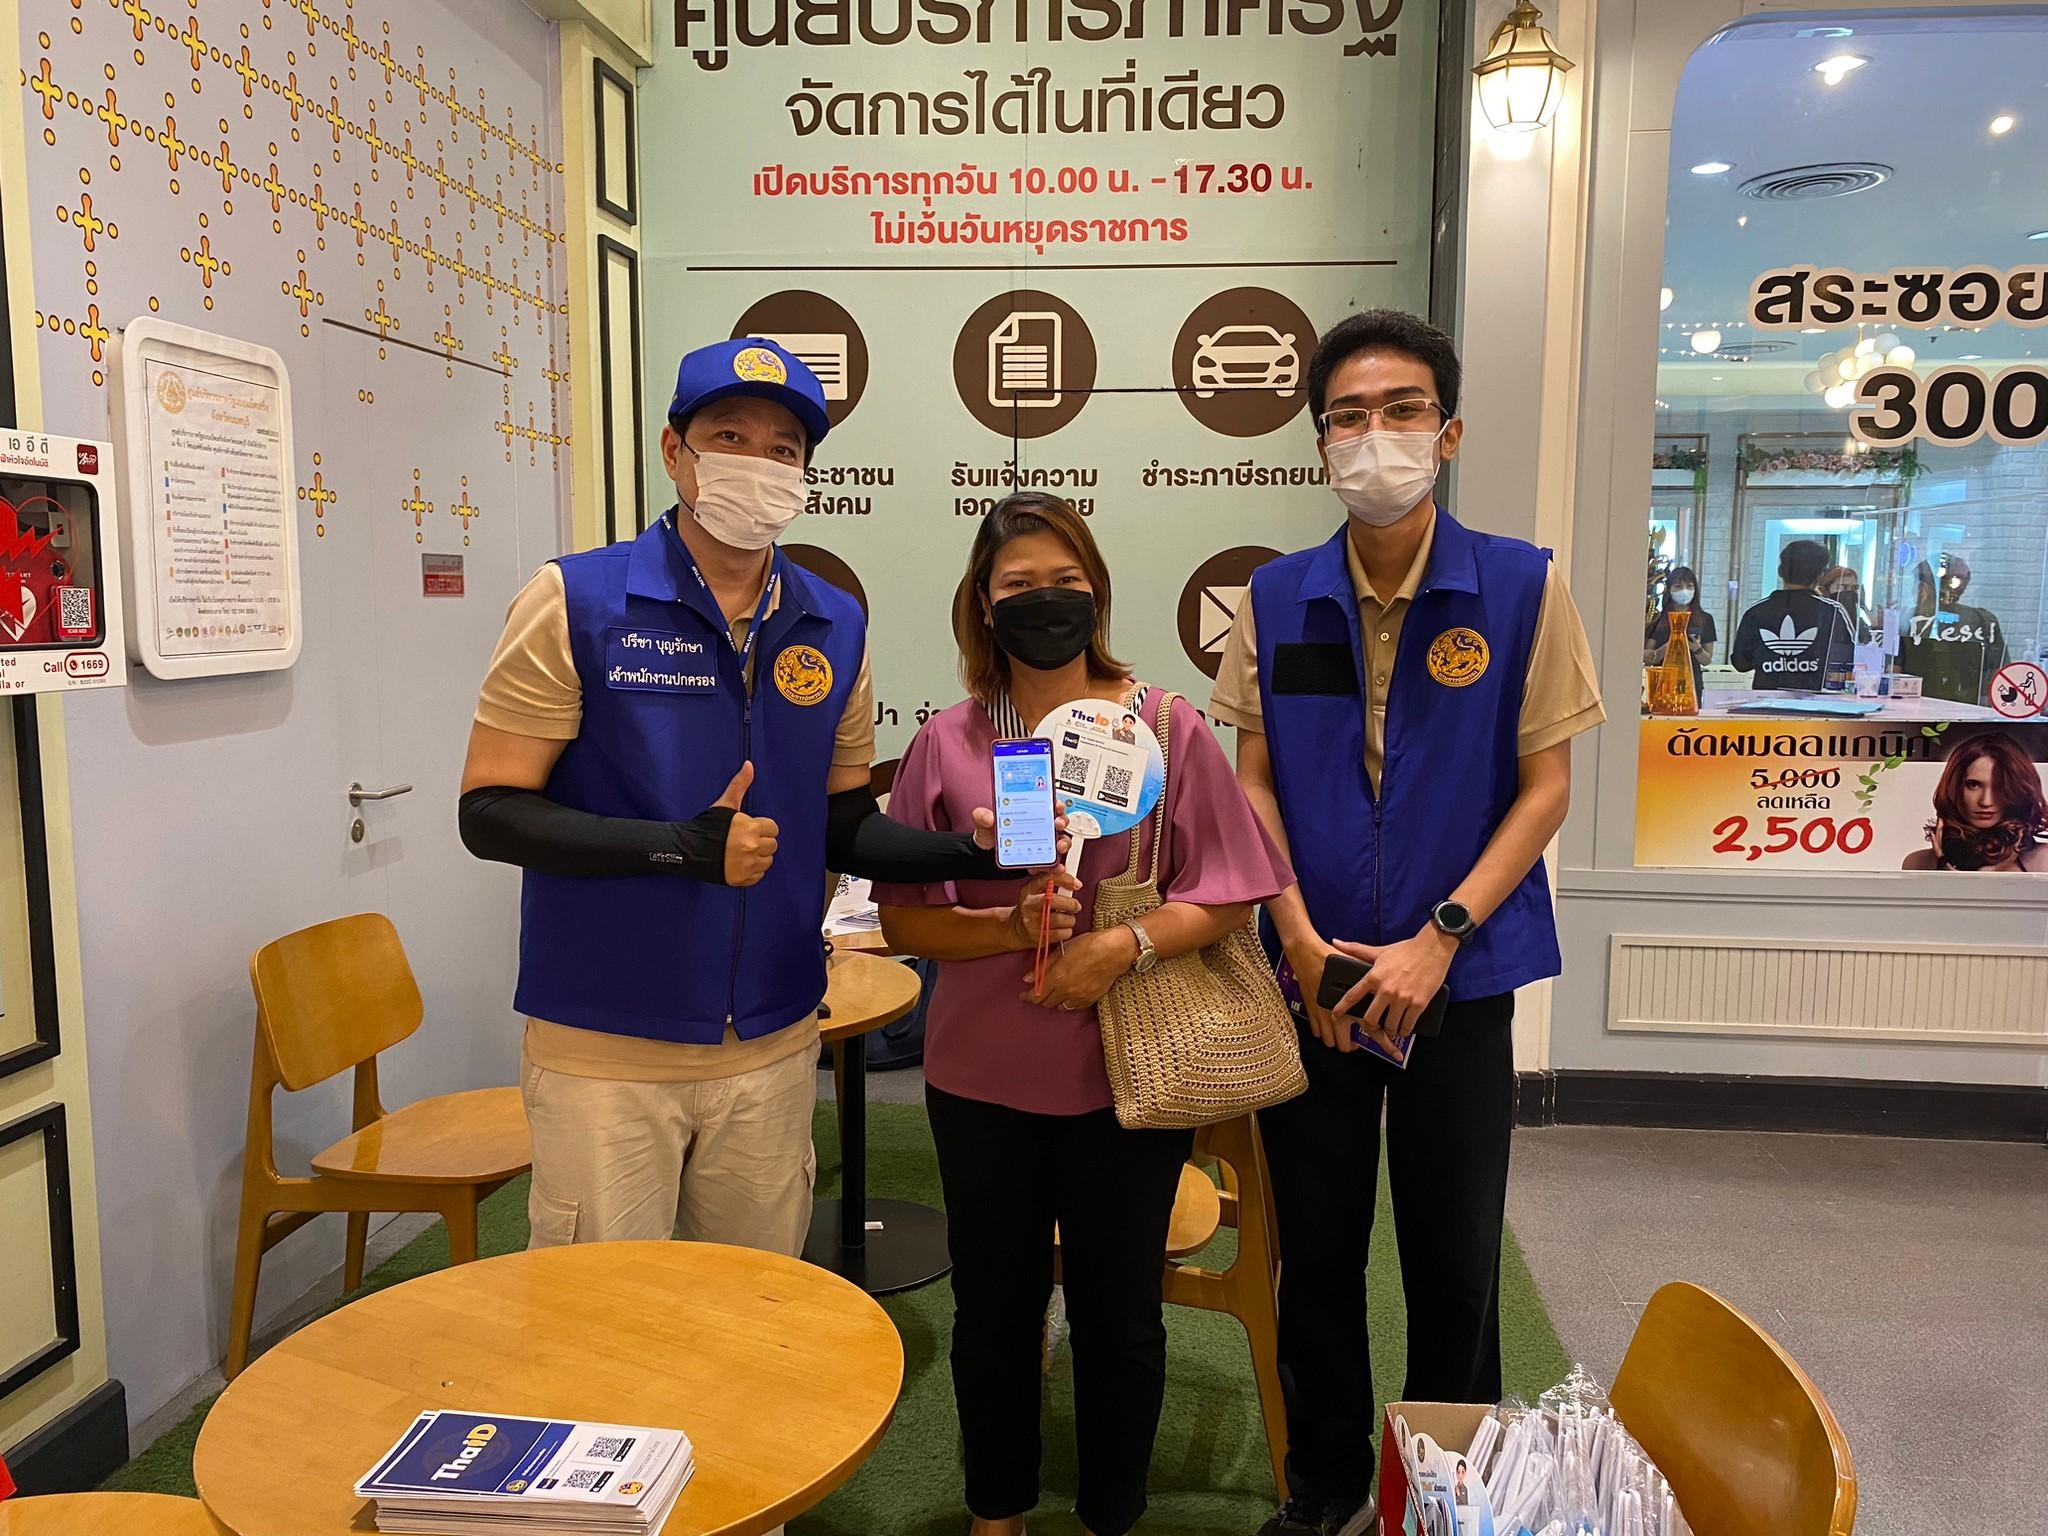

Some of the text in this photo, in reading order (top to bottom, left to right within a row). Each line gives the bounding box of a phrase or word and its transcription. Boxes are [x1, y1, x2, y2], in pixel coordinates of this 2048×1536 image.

[785, 60, 1285, 137] จัดการได้ในที่เดียว
[753, 164, 998, 207] เปิดบริการทุกวัน
[1009, 166, 1098, 194] 10.00
[1108, 169, 1140, 193] น.
[1174, 163, 1273, 194] 17.30
[1281, 166, 1313, 190] น.
[870, 211, 1189, 255] ไม่เว้นวันหยุดราชการ
[1857, 371, 2048, 441] 300
[804, 467, 894, 486] ระชาชน
[951, 461, 1098, 487] รับแจ้งความ
[1142, 459, 1331, 487] ชำระภาษีรถยน
[804, 490, 872, 515] สังคม
[621, 633, 703, 656] ปรีชา บุญรักษา
[43, 659, 104, 673] Call 1669
[608, 666, 716, 687] เจ้าพนักงานปกครอง
[1762, 656, 1820, 674] adidas
[1750, 767, 1841, 791] 5,000
[1756, 792, 1831, 810] ลดเหลือ
[1712, 815, 1874, 862] 2,500
